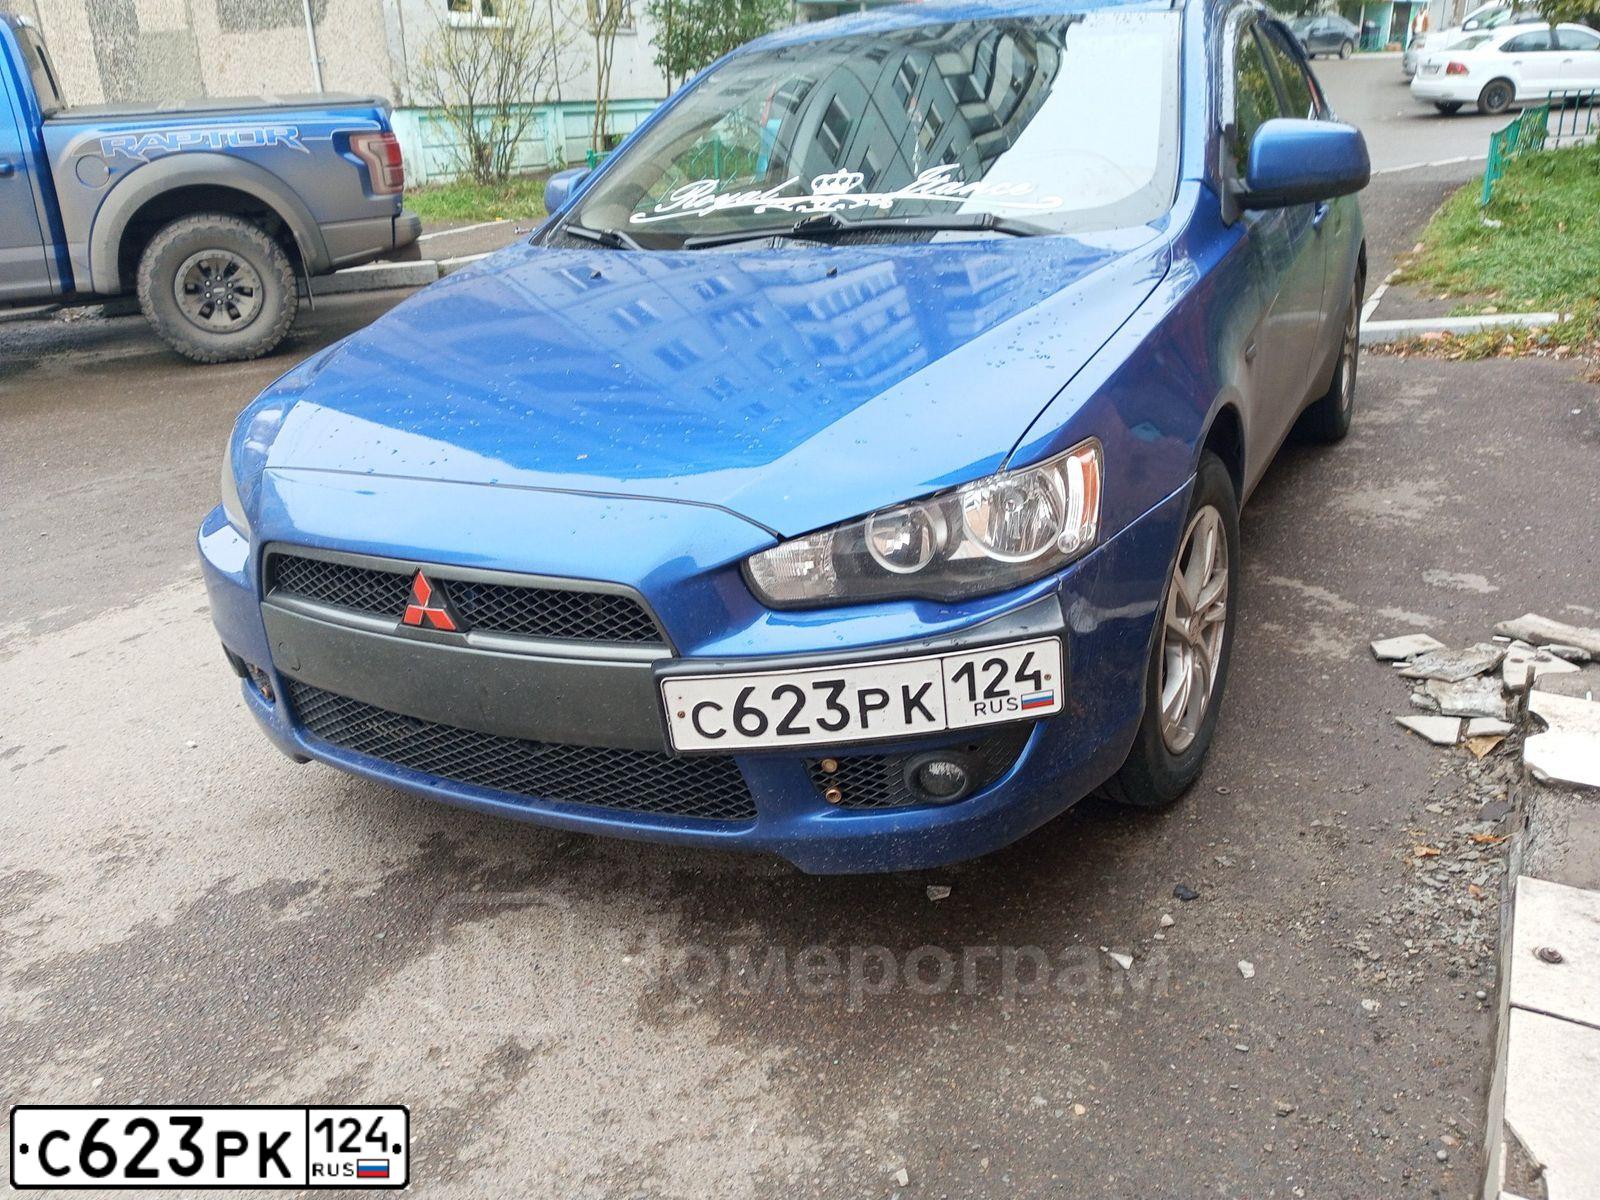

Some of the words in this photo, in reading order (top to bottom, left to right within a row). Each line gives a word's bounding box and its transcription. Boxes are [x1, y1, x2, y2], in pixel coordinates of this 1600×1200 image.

[99, 125, 310, 163] RAPTOR
[655, 176, 799, 216] Royal
[951, 651, 1042, 702] 124
[973, 696, 1019, 717] RUS
